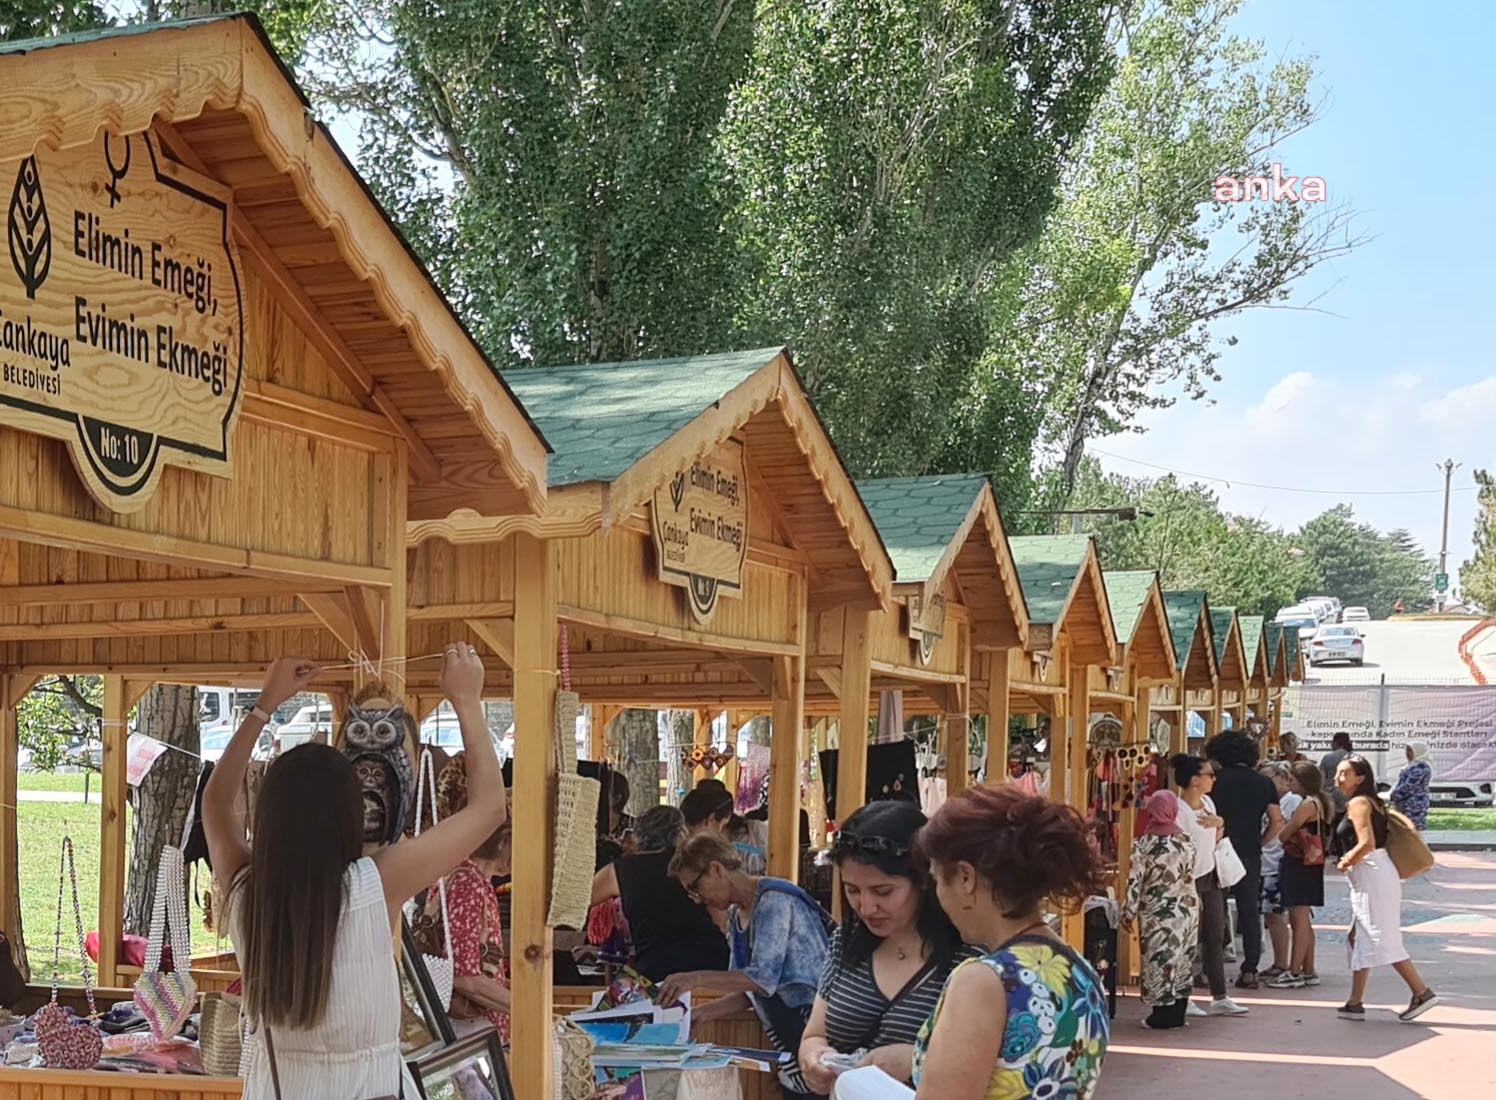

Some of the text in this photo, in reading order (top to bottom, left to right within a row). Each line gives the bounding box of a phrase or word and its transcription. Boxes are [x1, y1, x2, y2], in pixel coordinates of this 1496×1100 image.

[74, 209, 218, 317] Elimin Emeği,
[4, 363, 61, 397] BELEDİYESİ
[74, 295, 228, 396] Evimin Ekmeği
[100, 426, 139, 465] No: 10
